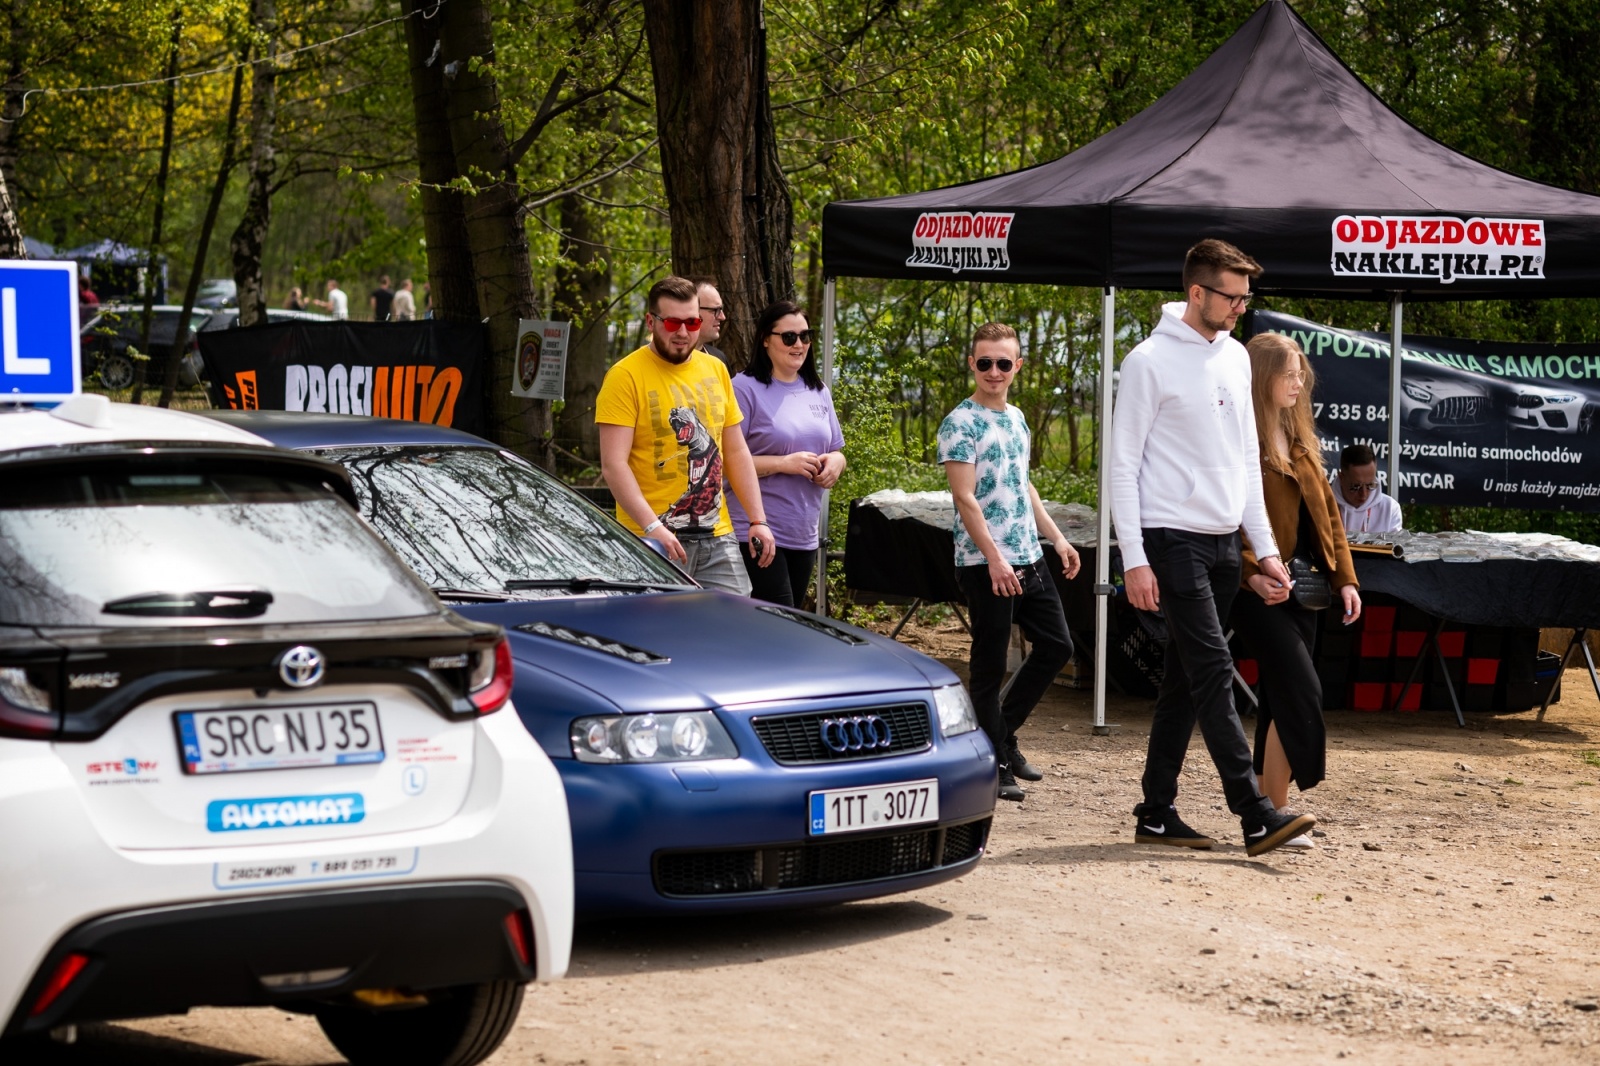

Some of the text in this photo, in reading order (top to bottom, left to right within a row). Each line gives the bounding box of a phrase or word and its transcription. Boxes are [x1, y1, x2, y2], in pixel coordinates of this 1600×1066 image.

[916, 215, 1011, 244] ODJAZDOWE
[1336, 219, 1542, 250] ODJAZDOWE
[2, 287, 51, 375] L
[1328, 403, 1361, 420] 335
[1366, 405, 1390, 421] 84
[1320, 436, 1340, 452] tri
[1481, 445, 1582, 463] samochodów
[1376, 470, 1454, 489] RNTCAR
[1483, 478, 1493, 491] U
[1495, 482, 1518, 493] nas
[1520, 480, 1557, 497] każdy
[204, 708, 371, 758] SRC NJ35
[221, 798, 354, 829] AUTOMAT
[832, 787, 930, 827] 1TT 3077
[812, 819, 824, 829] CZ
